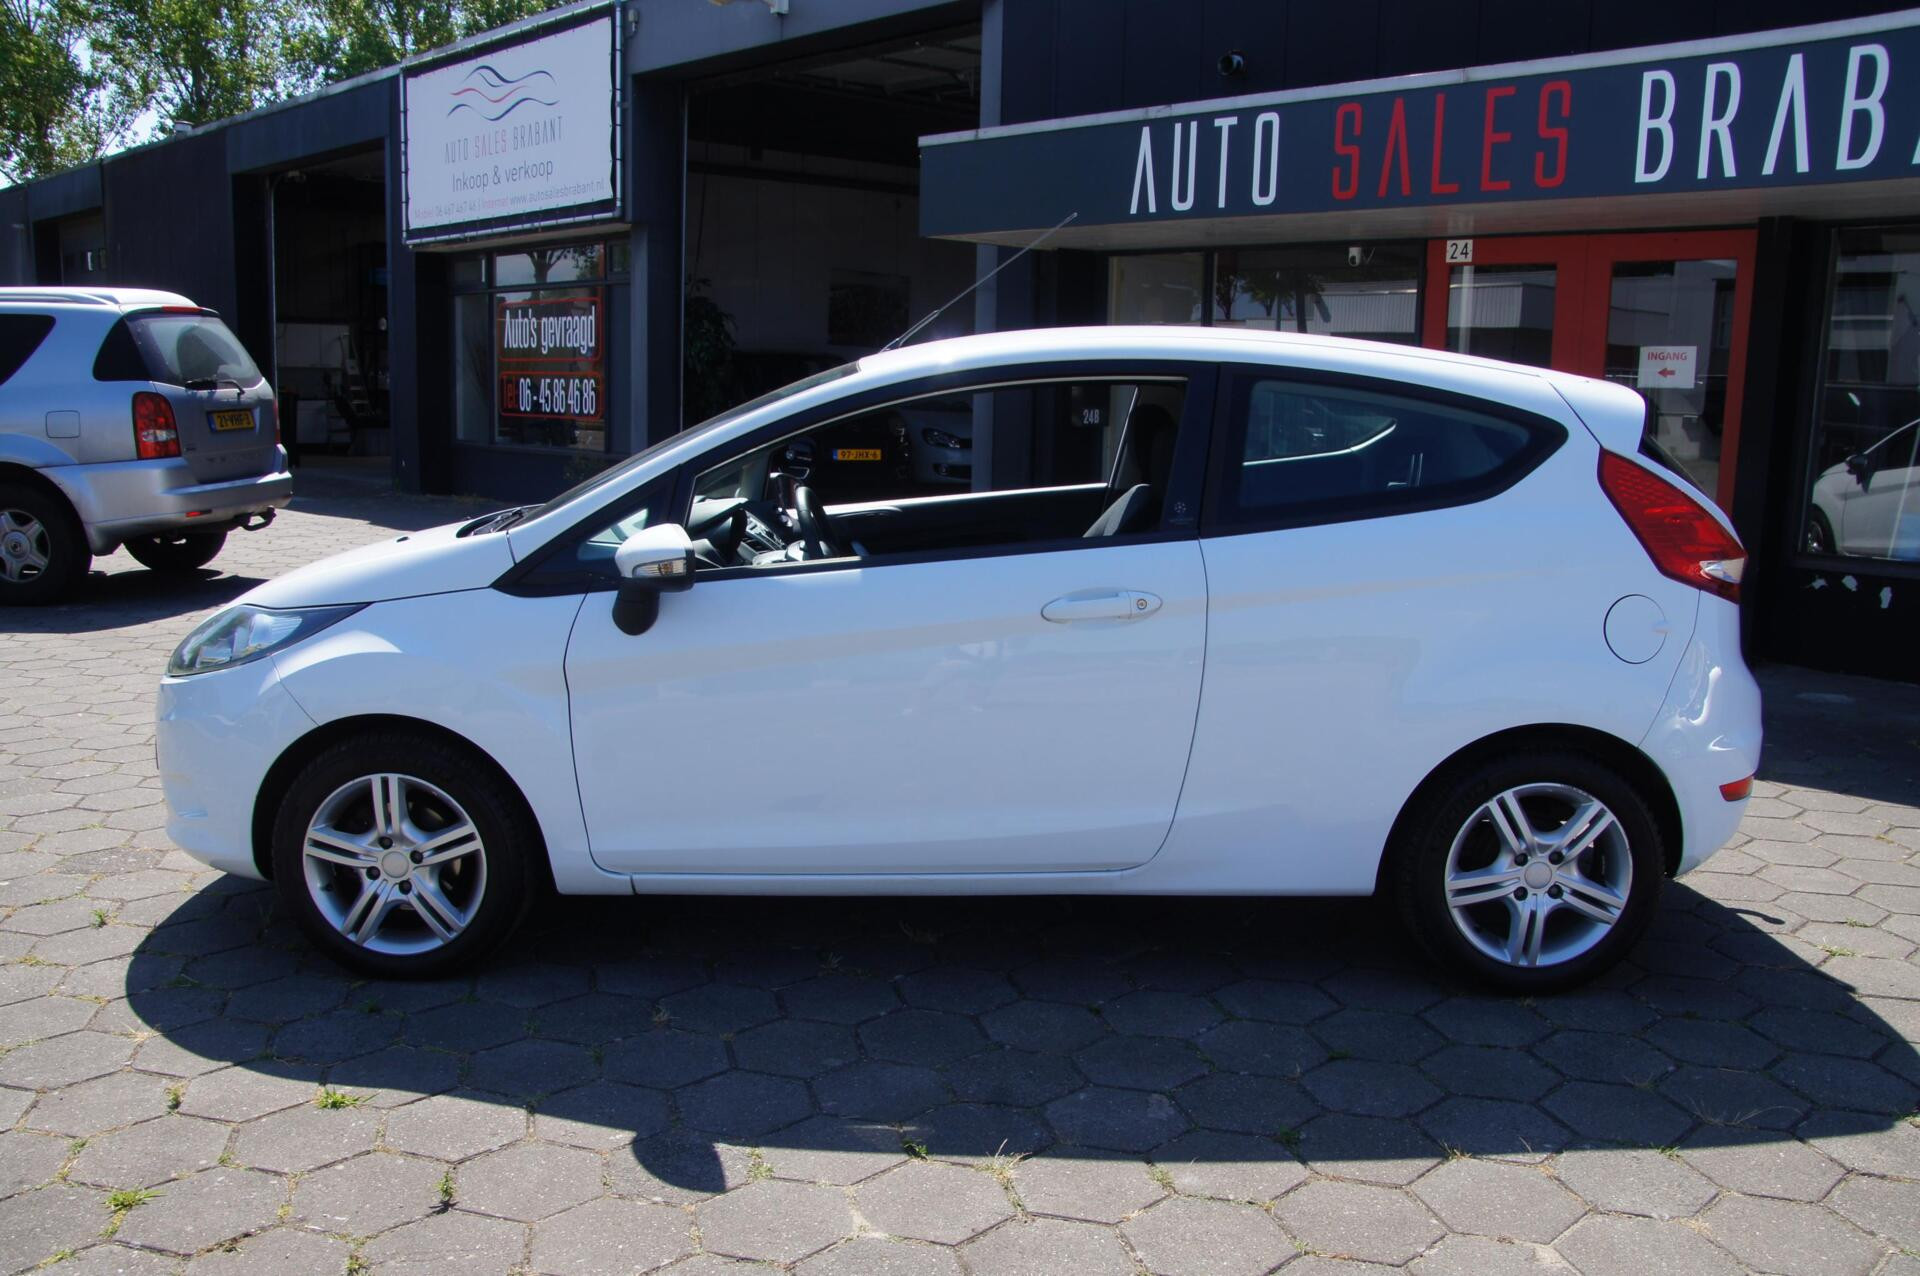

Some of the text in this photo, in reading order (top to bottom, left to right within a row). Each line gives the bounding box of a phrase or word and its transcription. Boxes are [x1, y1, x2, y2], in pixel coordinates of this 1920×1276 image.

[445, 116, 564, 164] AUTO SALES BRABANT
[1130, 44, 1920, 214] AUTO SALES BRAB
[452, 159, 553, 193] Inkoop & verkoop
[510, 179, 605, 205] www.autosalesbrabant.nl
[1450, 242, 1469, 260] 24
[504, 305, 595, 354] Auto's gevraagd
[1647, 351, 1688, 361] INGANG
[519, 378, 532, 412] 06
[539, 378, 551, 412] 45
[553, 378, 566, 413] 86
[567, 378, 580, 414] 46
[582, 378, 596, 414] 86
